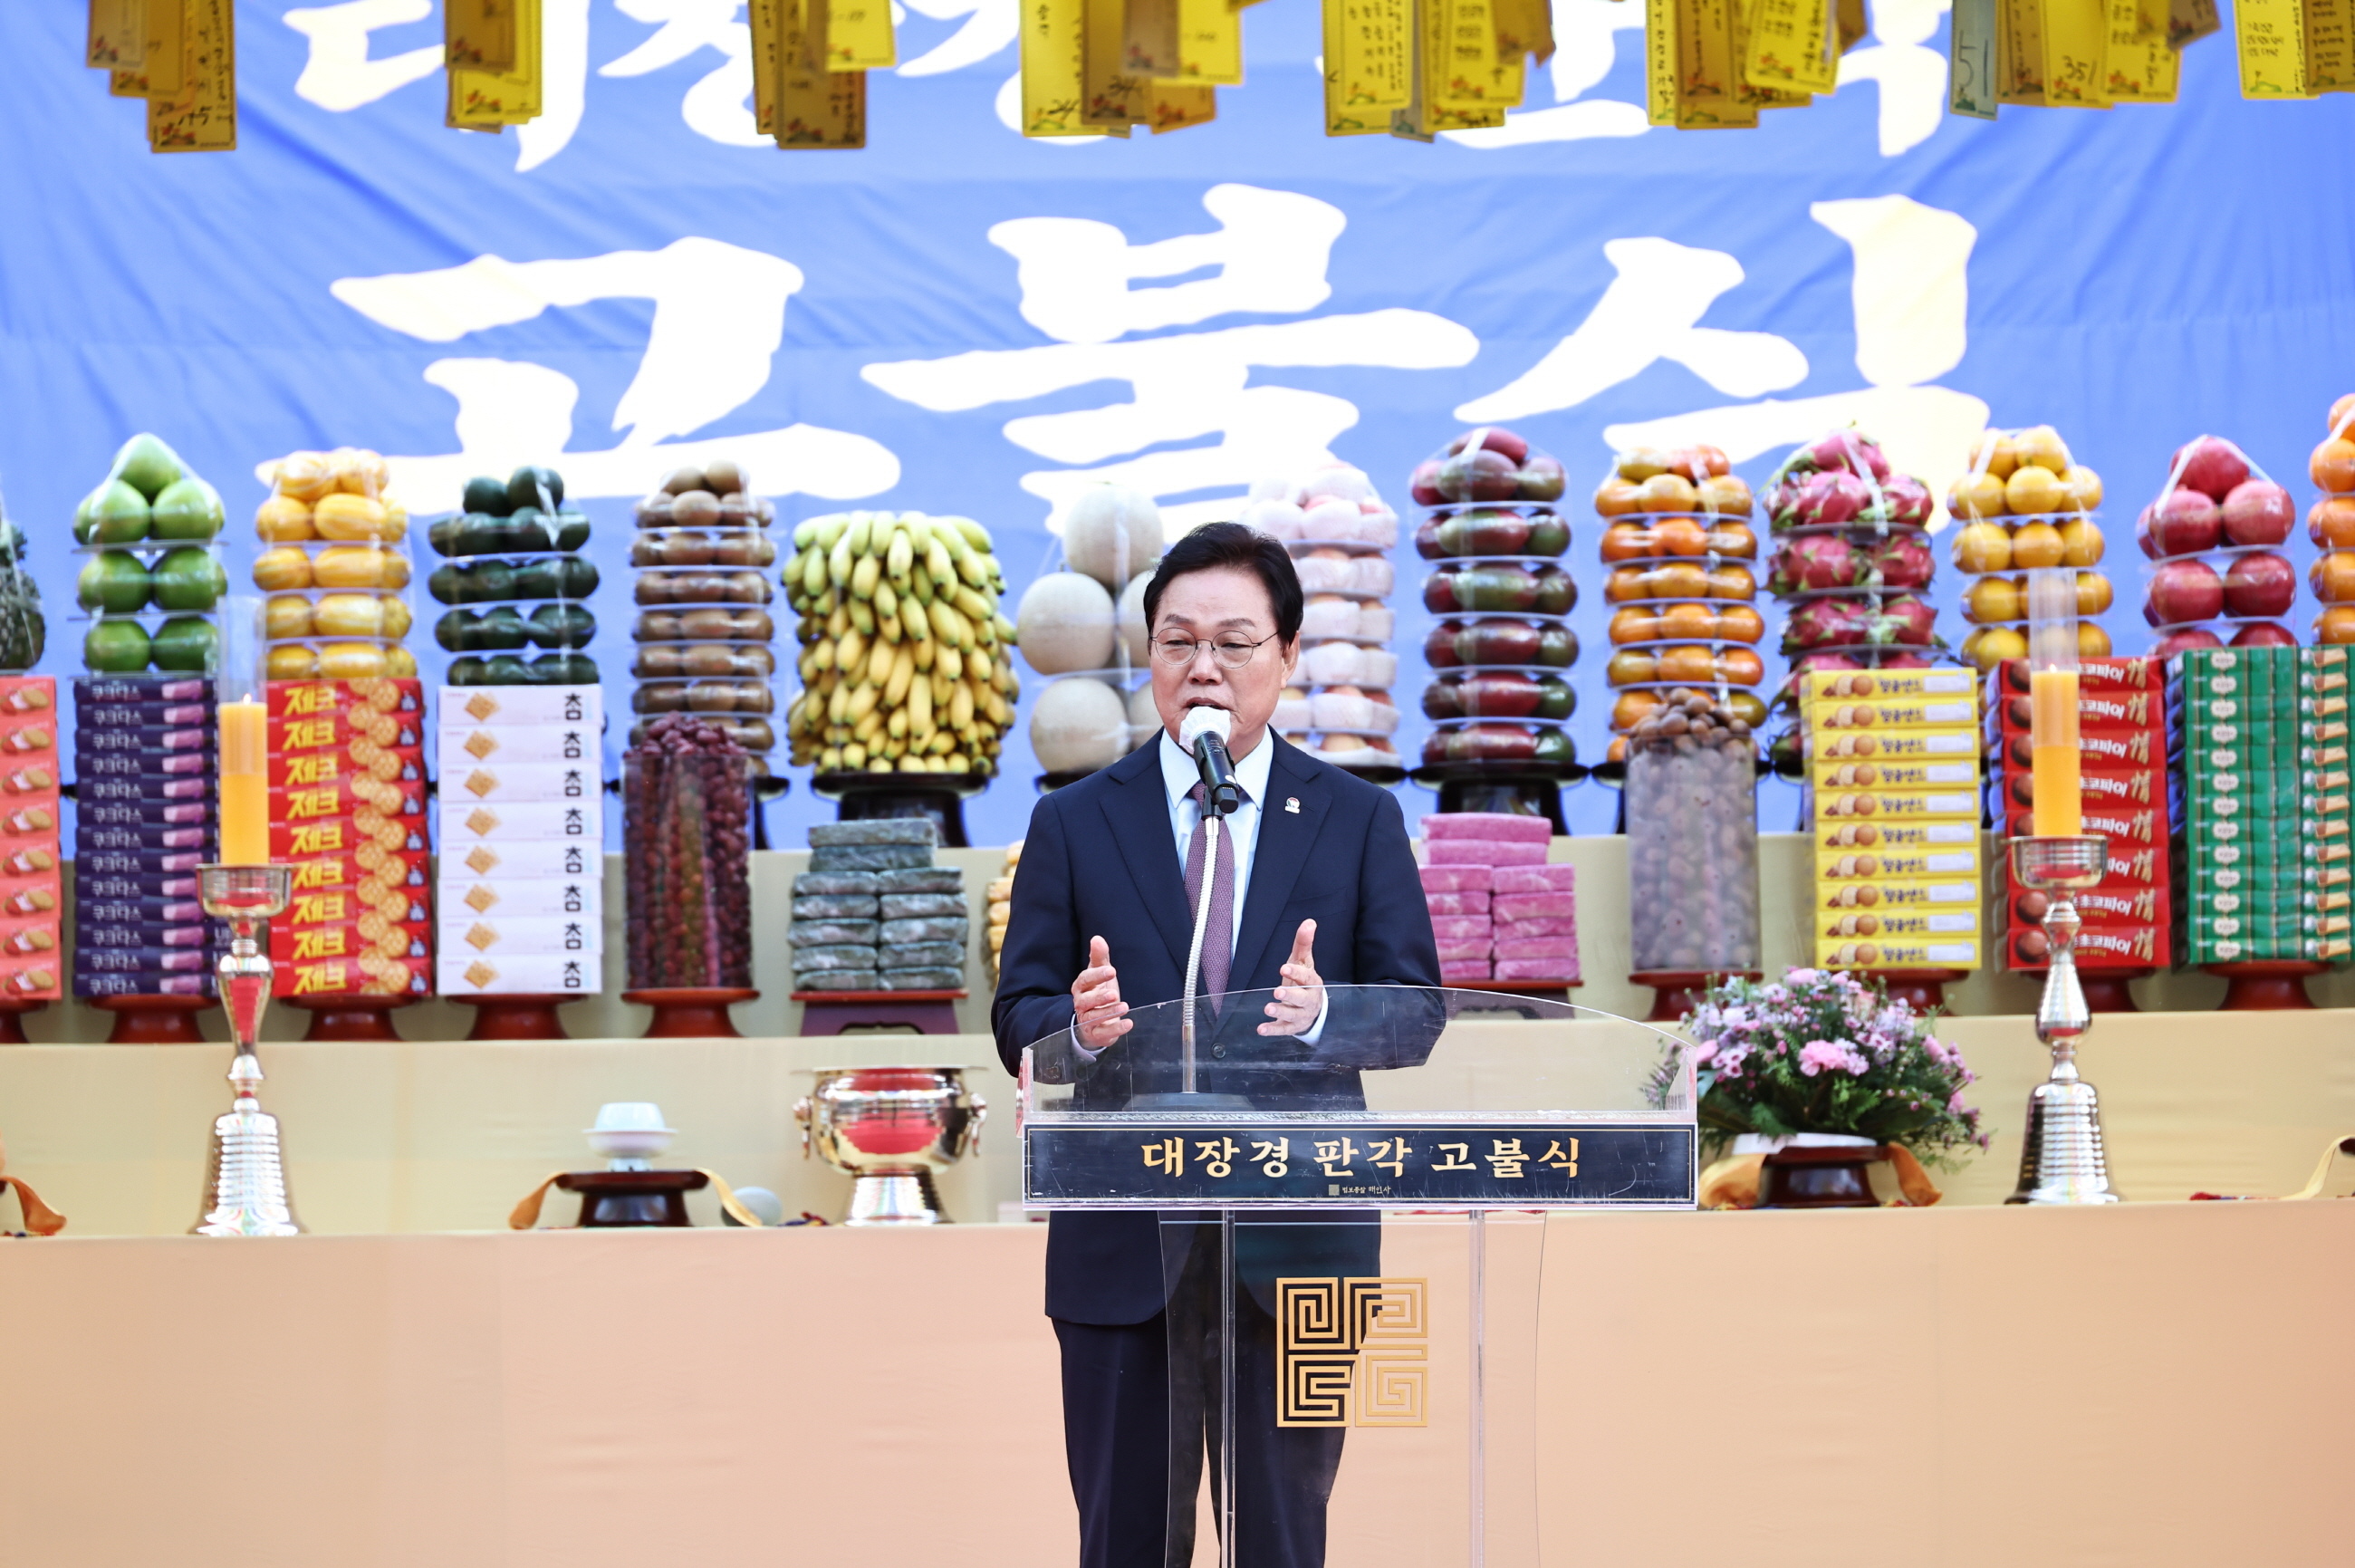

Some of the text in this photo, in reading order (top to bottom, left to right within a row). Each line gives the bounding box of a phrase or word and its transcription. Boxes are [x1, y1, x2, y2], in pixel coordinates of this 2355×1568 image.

[1958, 28, 1988, 97] 51
[2062, 54, 2098, 86] 351
[91, 685, 140, 702] 쿠크다스
[285, 684, 337, 716] 제크
[94, 709, 142, 726] 쿠크다스
[93, 734, 141, 751] 쿠크다스
[284, 717, 337, 751] 제크
[92, 758, 140, 775] 쿠크다스
[286, 753, 339, 786] 제크
[93, 783, 141, 800] 쿠크다스
[287, 786, 340, 821] 제크
[94, 807, 142, 824] 쿠크다스
[93, 832, 141, 849] 쿠크다스
[291, 822, 343, 855] 제크
[93, 856, 141, 873] 쿠크다스
[291, 857, 344, 890] 제크
[92, 880, 140, 898] 쿠크다스
[92, 904, 141, 921] 쿠크다스
[293, 891, 346, 925] 제크
[2080, 893, 2133, 916] 초코파이
[93, 928, 140, 946] 쿠크다스
[293, 928, 347, 960] 제크
[2080, 933, 2132, 956] 초코파이
[91, 953, 139, 970] 쿠크다스
[90, 976, 139, 994] 쿠크다스
[294, 964, 348, 996] 제크
[1140, 1136, 1581, 1178] 대장경 판각 고불식
[1368, 1185, 1391, 1195] 해인사
